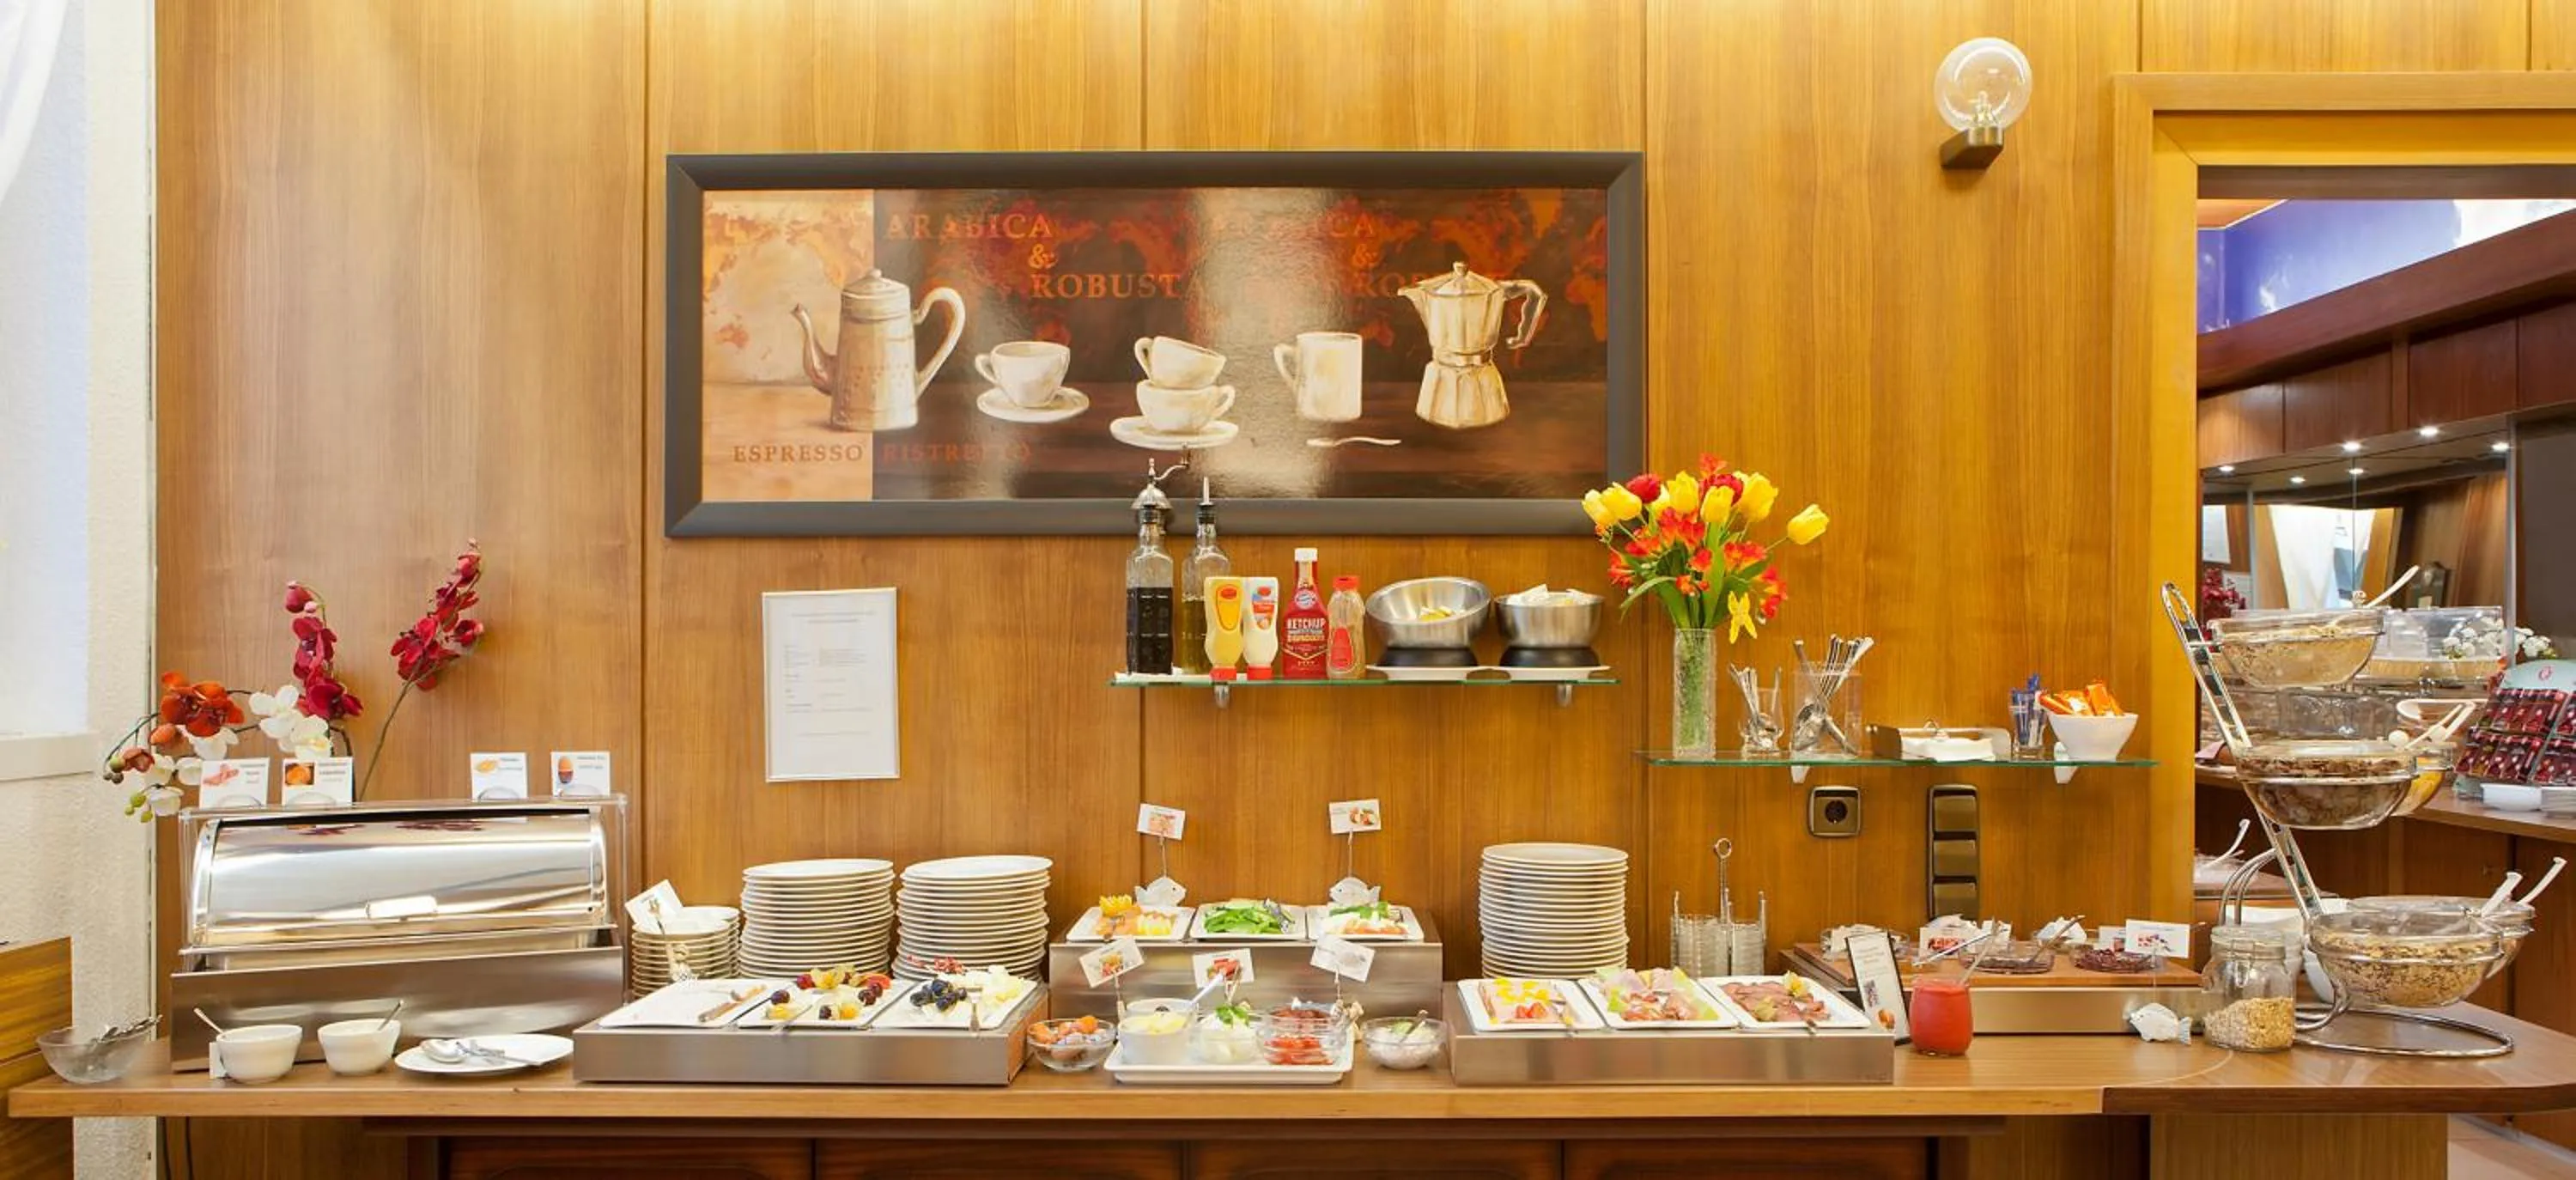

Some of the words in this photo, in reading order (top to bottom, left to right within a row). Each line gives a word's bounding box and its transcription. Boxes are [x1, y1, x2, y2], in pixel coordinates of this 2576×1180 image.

[884, 213, 1053, 239] ARABICA
[1030, 243, 1059, 269] &
[732, 444, 864, 463] ESPRESSO
